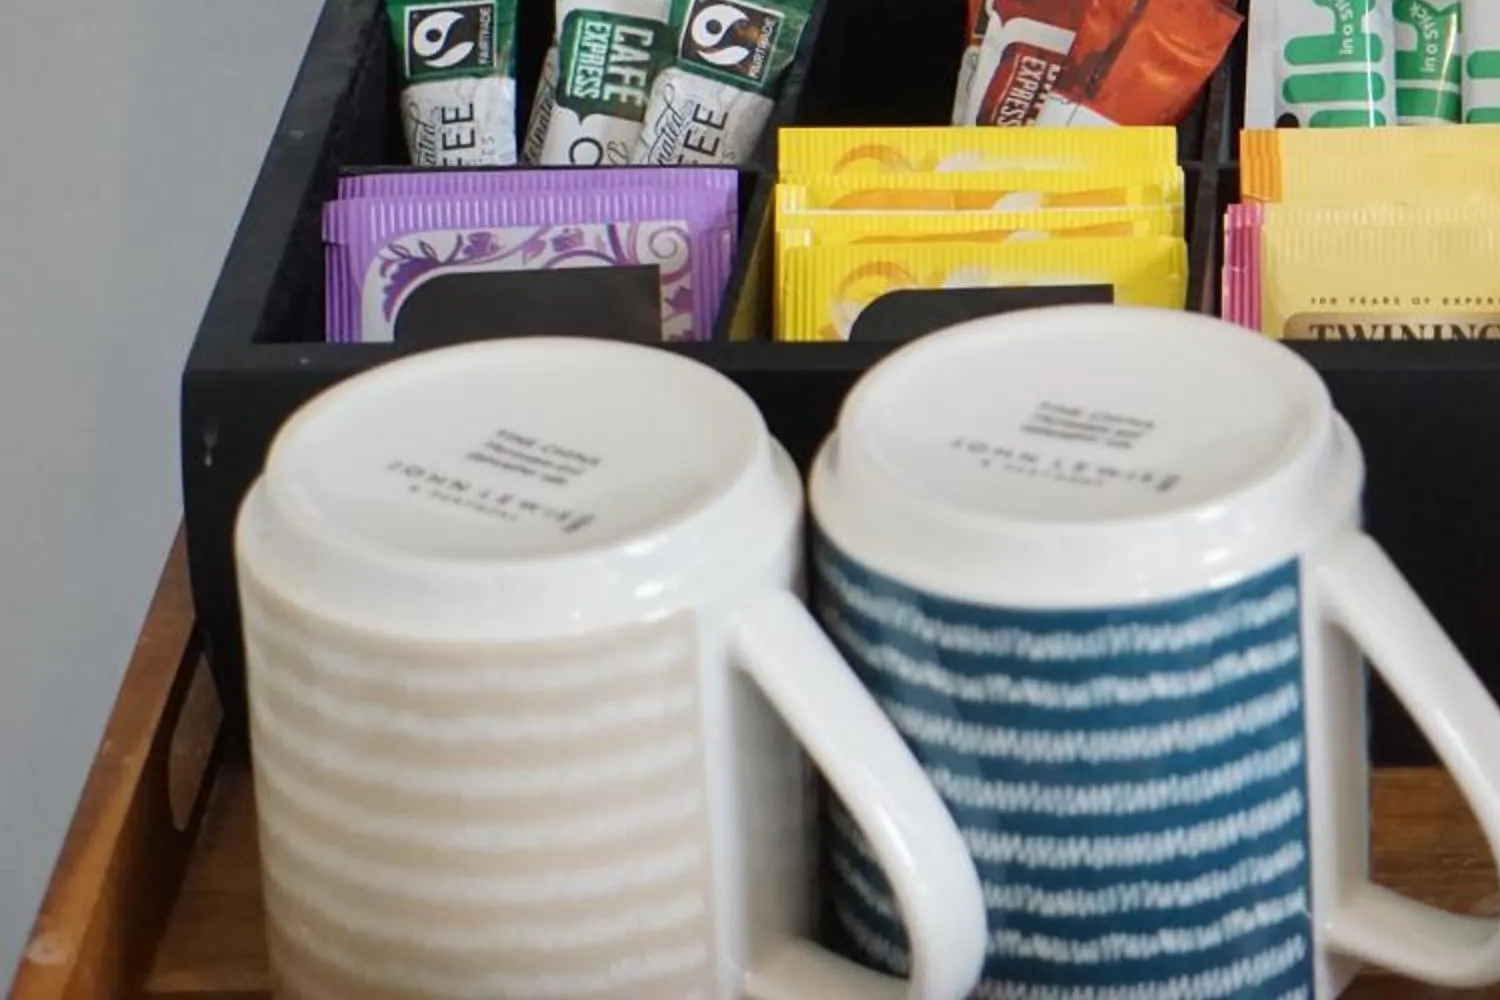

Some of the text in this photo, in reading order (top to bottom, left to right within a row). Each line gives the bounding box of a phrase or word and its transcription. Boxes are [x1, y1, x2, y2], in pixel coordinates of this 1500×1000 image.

[477, 6, 493, 66] FAIRTRADE
[573, 19, 613, 100] EXPRESS
[1348, 296, 1401, 306] YEARS
[1411, 296, 1432, 306] OF
